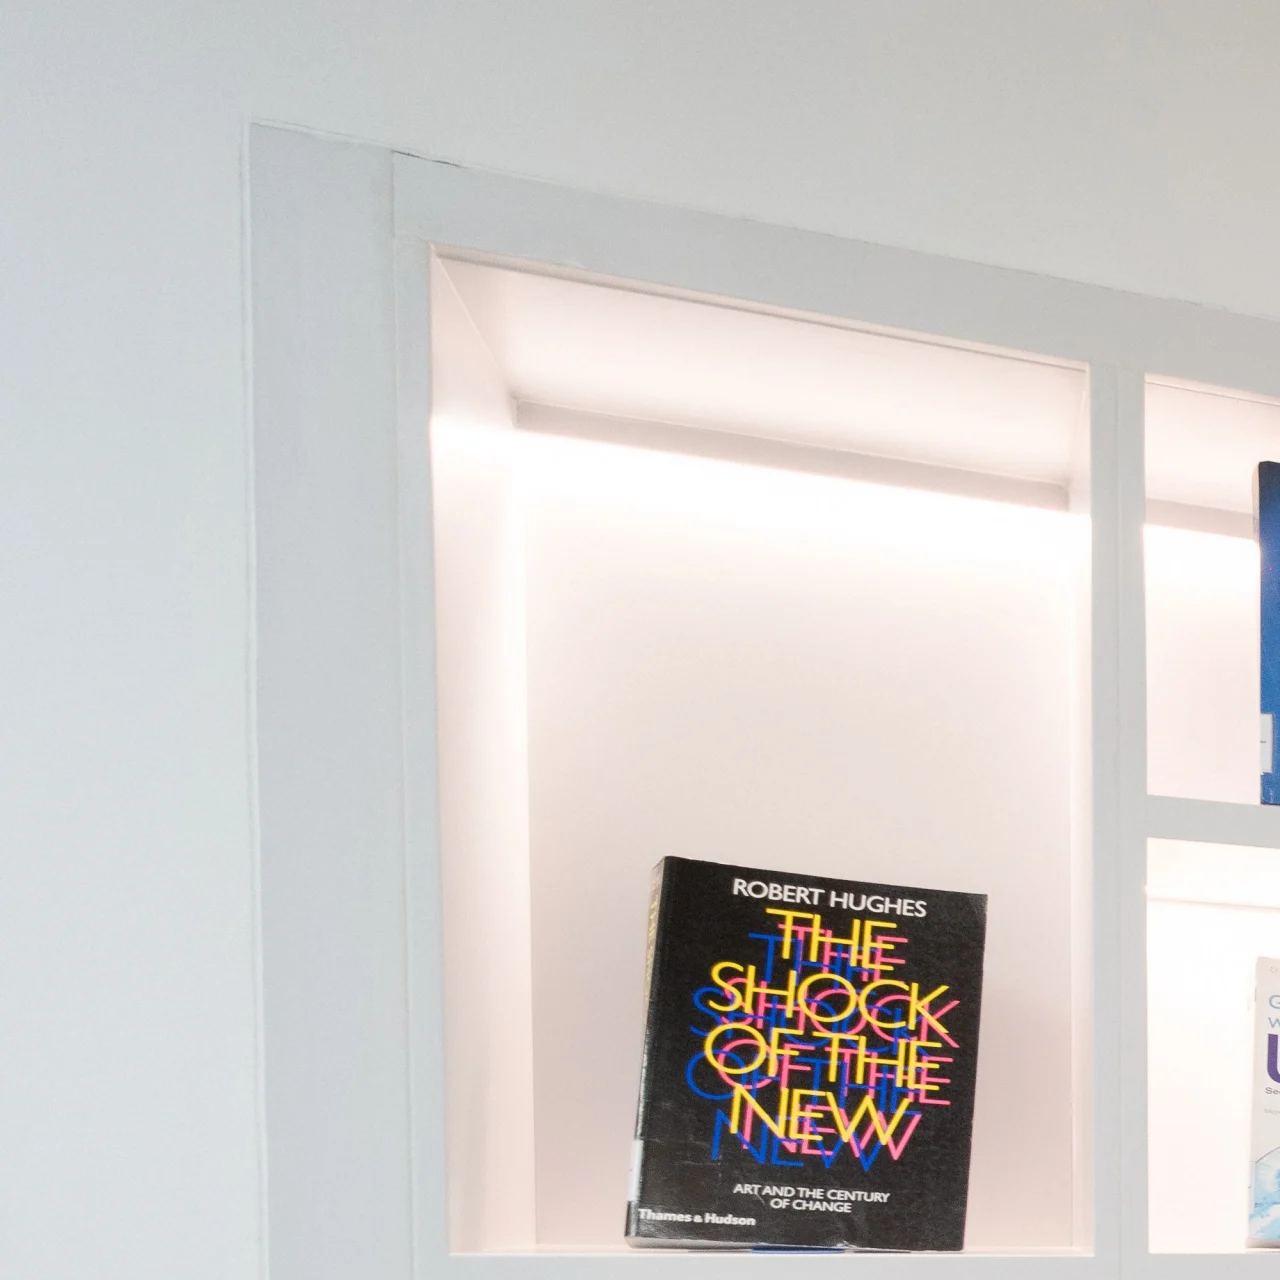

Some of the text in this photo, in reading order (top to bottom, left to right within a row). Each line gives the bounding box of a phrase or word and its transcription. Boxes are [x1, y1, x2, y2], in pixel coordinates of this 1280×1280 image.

[733, 878, 927, 917] ROBERT HUGHES
[766, 908, 897, 971] THE
[709, 961, 950, 1034] SHOCK
[705, 1023, 942, 1091] OF THE
[729, 1084, 911, 1146] NEW
[638, 1208, 692, 1224] Thames
[704, 1212, 756, 1226] Hudson
[733, 1183, 890, 1203] ART AND THE CENTURY
[770, 1198, 852, 1213] OF CHANGE
